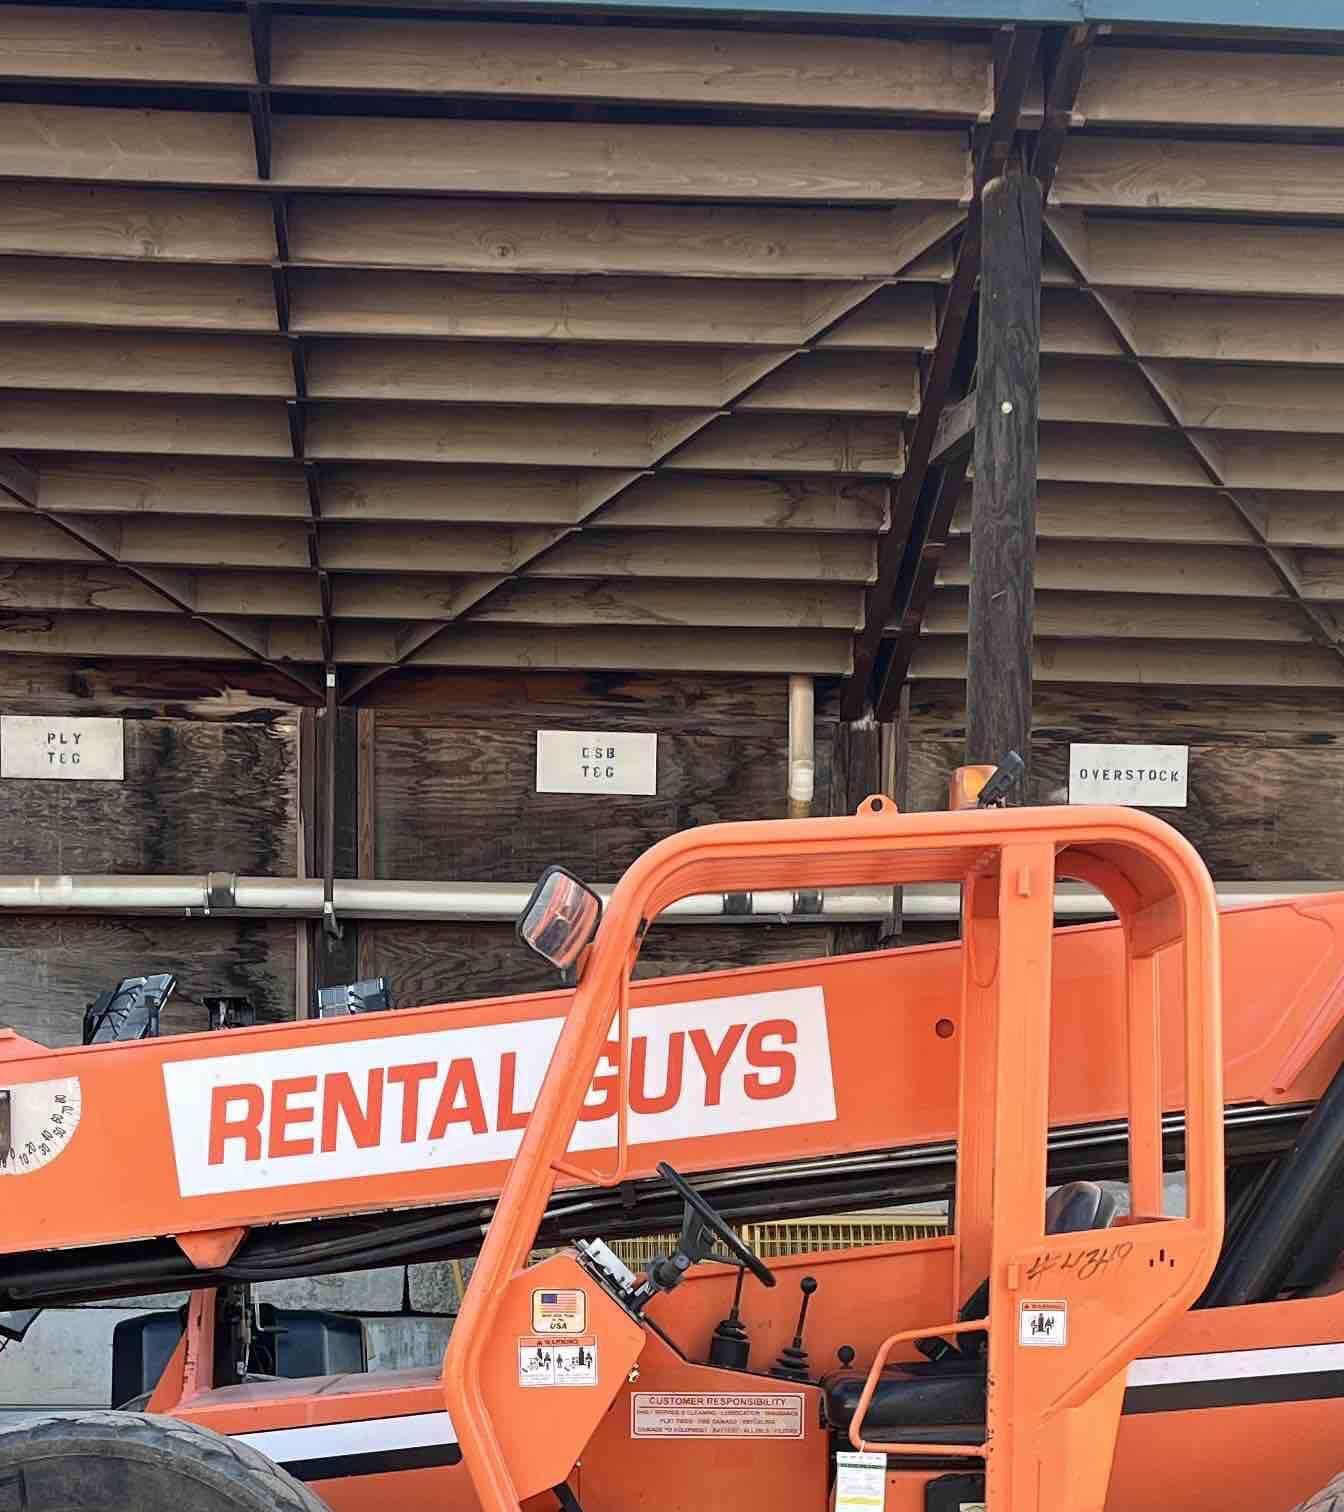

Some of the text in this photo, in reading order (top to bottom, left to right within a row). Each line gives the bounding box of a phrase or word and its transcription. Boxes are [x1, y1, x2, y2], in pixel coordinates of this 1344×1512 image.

[47, 732, 82, 745] PLY
[1079, 768, 1179, 782] OVERSTOCK
[206, 1018, 797, 1166] RENTAL GUYS
[549, 1322, 568, 1330] USA
[648, 1396, 786, 1407] CUSTOMER RESPONSIBILITY
